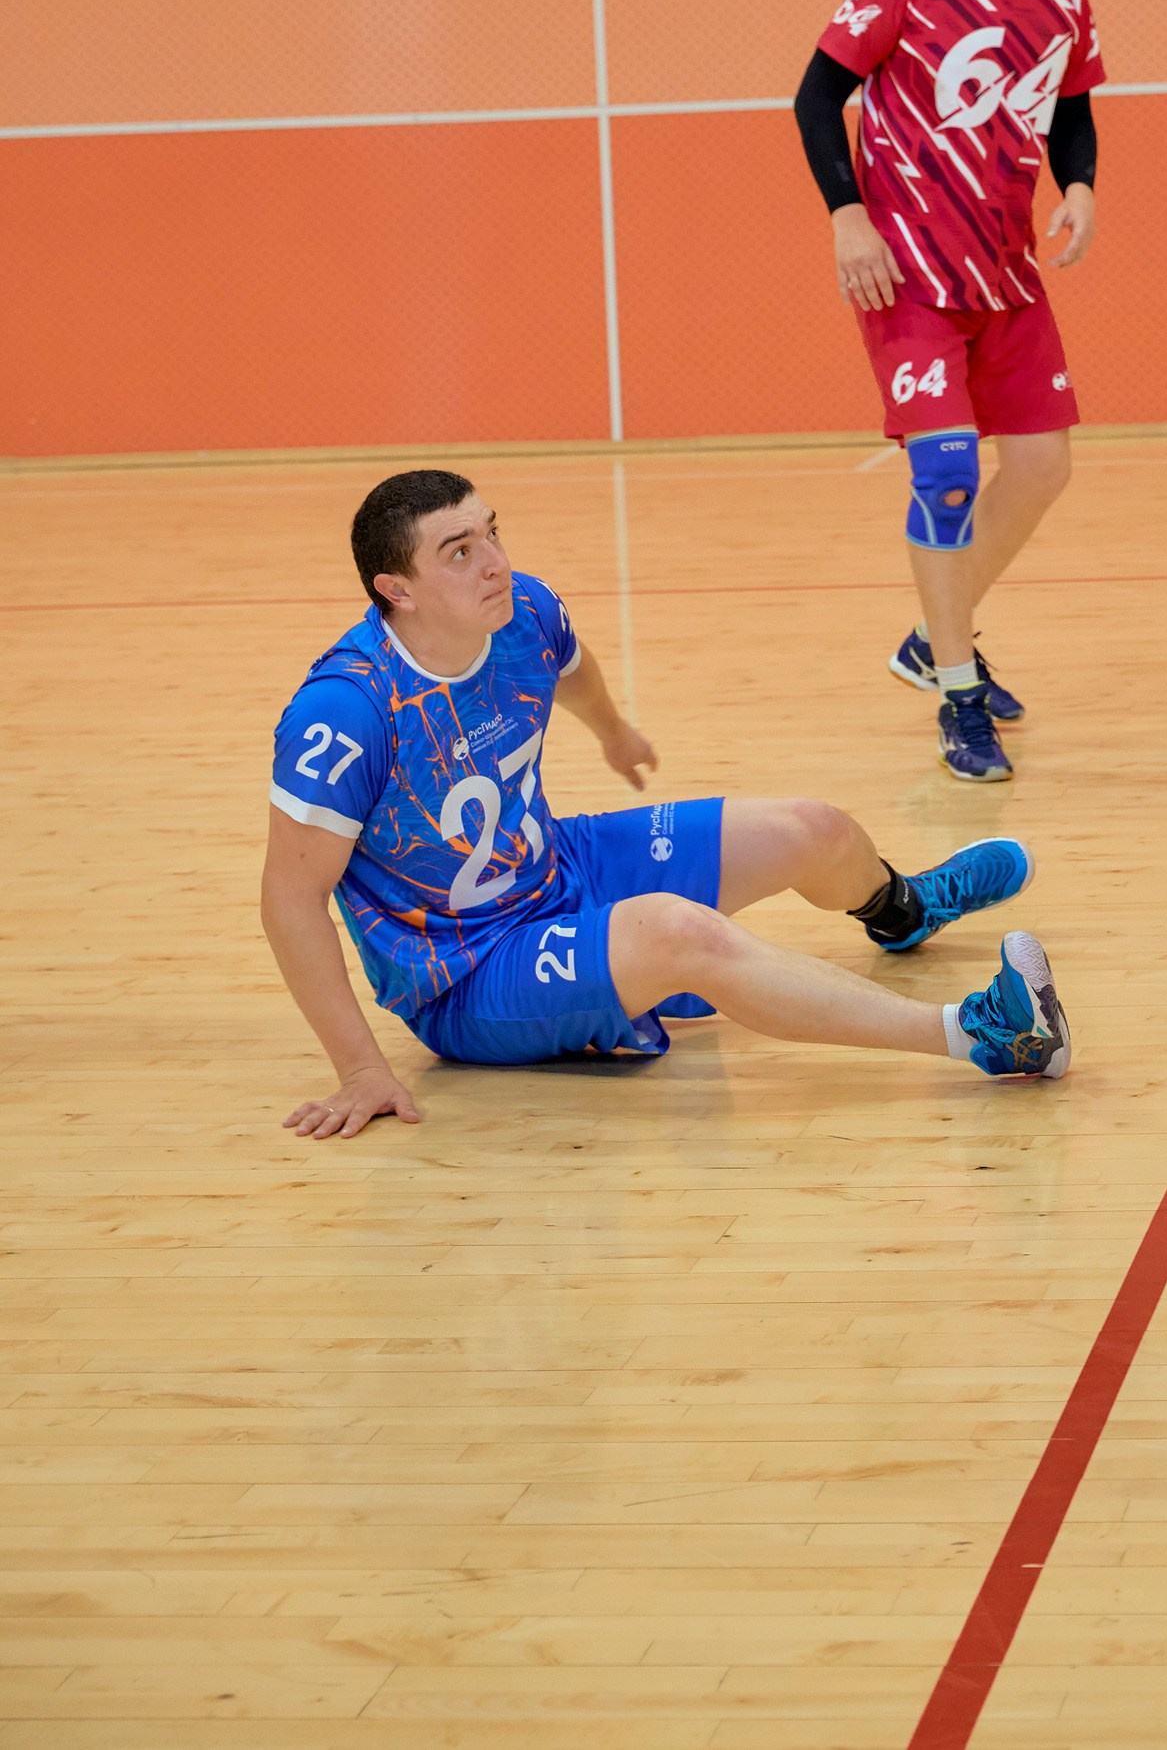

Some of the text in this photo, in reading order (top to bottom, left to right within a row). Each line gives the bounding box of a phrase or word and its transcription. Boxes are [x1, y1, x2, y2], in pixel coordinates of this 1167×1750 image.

[935, 26, 1074, 136] 64
[891, 358, 948, 407] 64
[295, 722, 364, 786] 27
[468, 713, 503, 740] РусГидро
[440, 728, 544, 911] 27
[535, 924, 577, 983] 27
